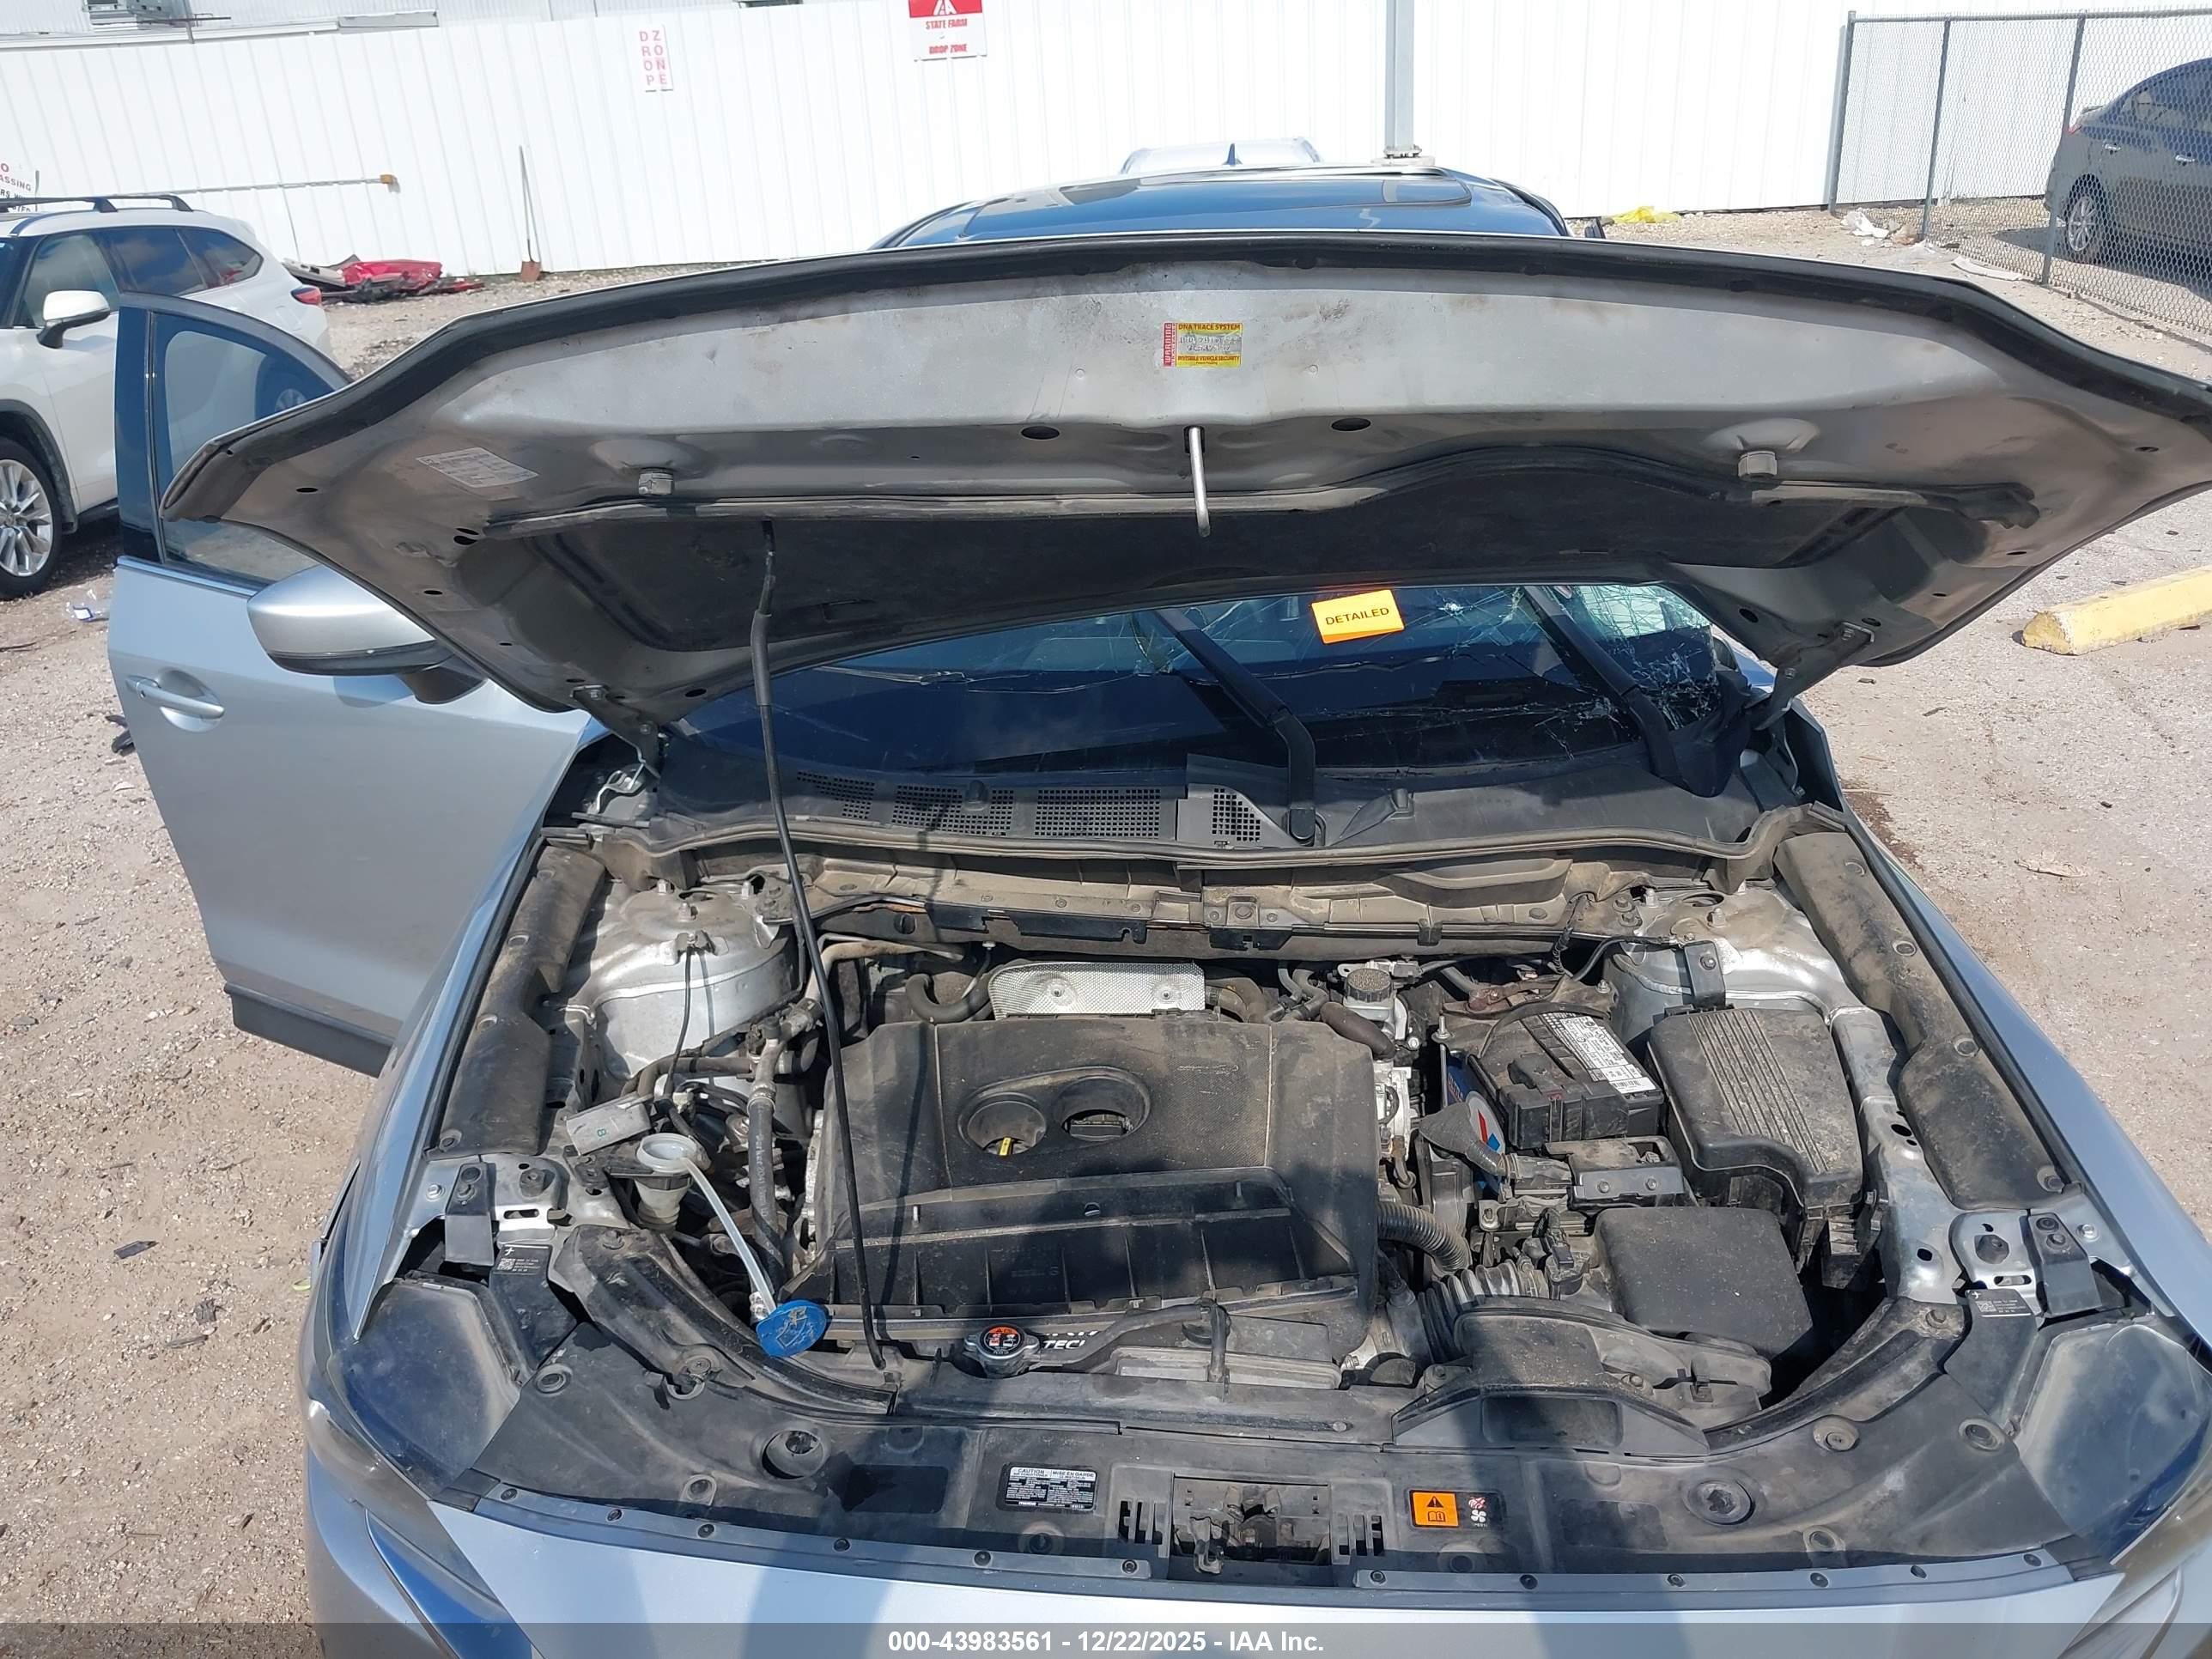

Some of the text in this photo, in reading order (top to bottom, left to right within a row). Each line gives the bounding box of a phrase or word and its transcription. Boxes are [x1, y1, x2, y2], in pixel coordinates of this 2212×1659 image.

[926, 18, 968, 30] STATE FARM
[639, 31, 654, 86] DROP
[653, 30, 667, 84] ZONE
[1326, 607, 1389, 625] DETAILED
